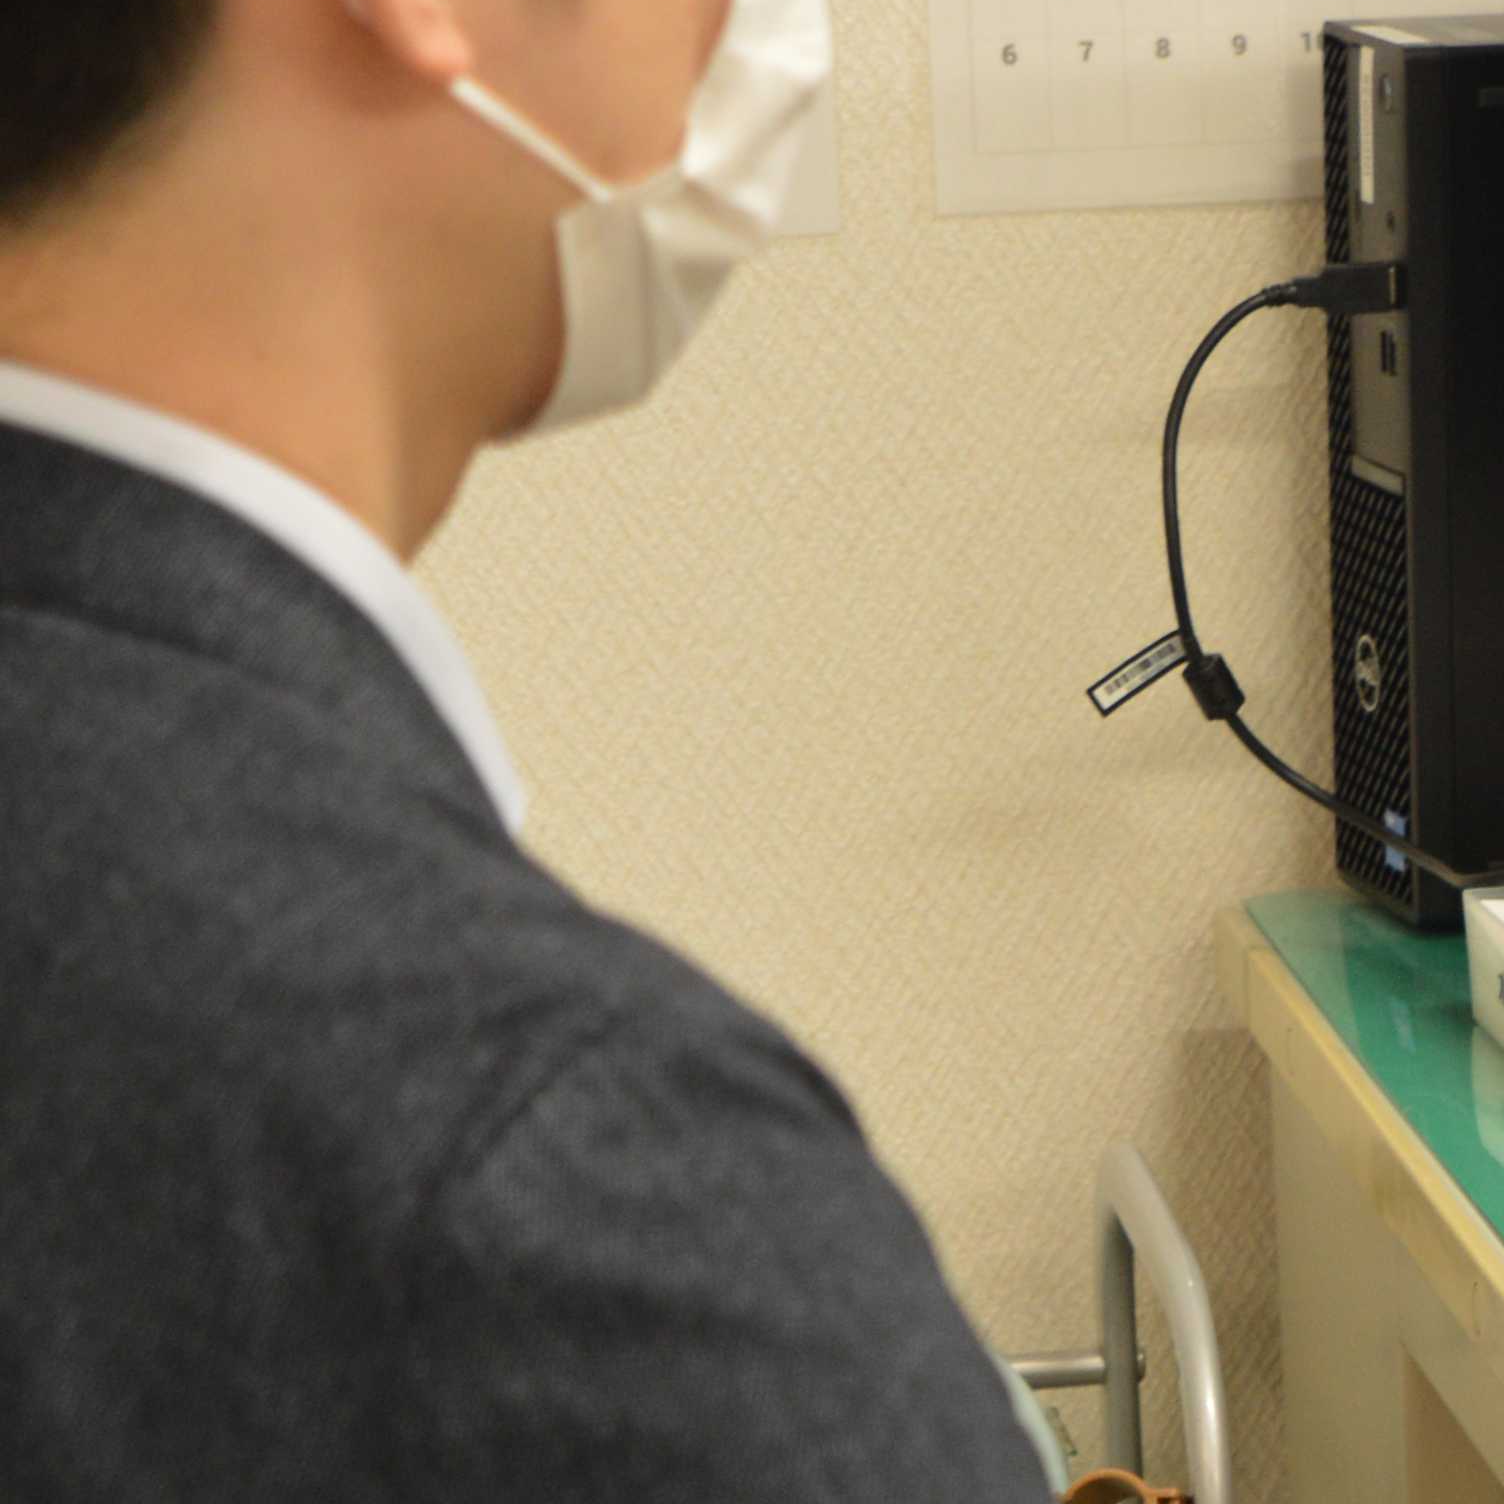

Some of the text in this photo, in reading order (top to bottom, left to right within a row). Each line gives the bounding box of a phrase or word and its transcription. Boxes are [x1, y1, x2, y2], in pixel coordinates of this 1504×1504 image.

[1002, 43, 1018, 66] 6
[1078, 40, 1093, 61] 7
[1156, 38, 1170, 60] 8
[1232, 34, 1247, 57] 9
